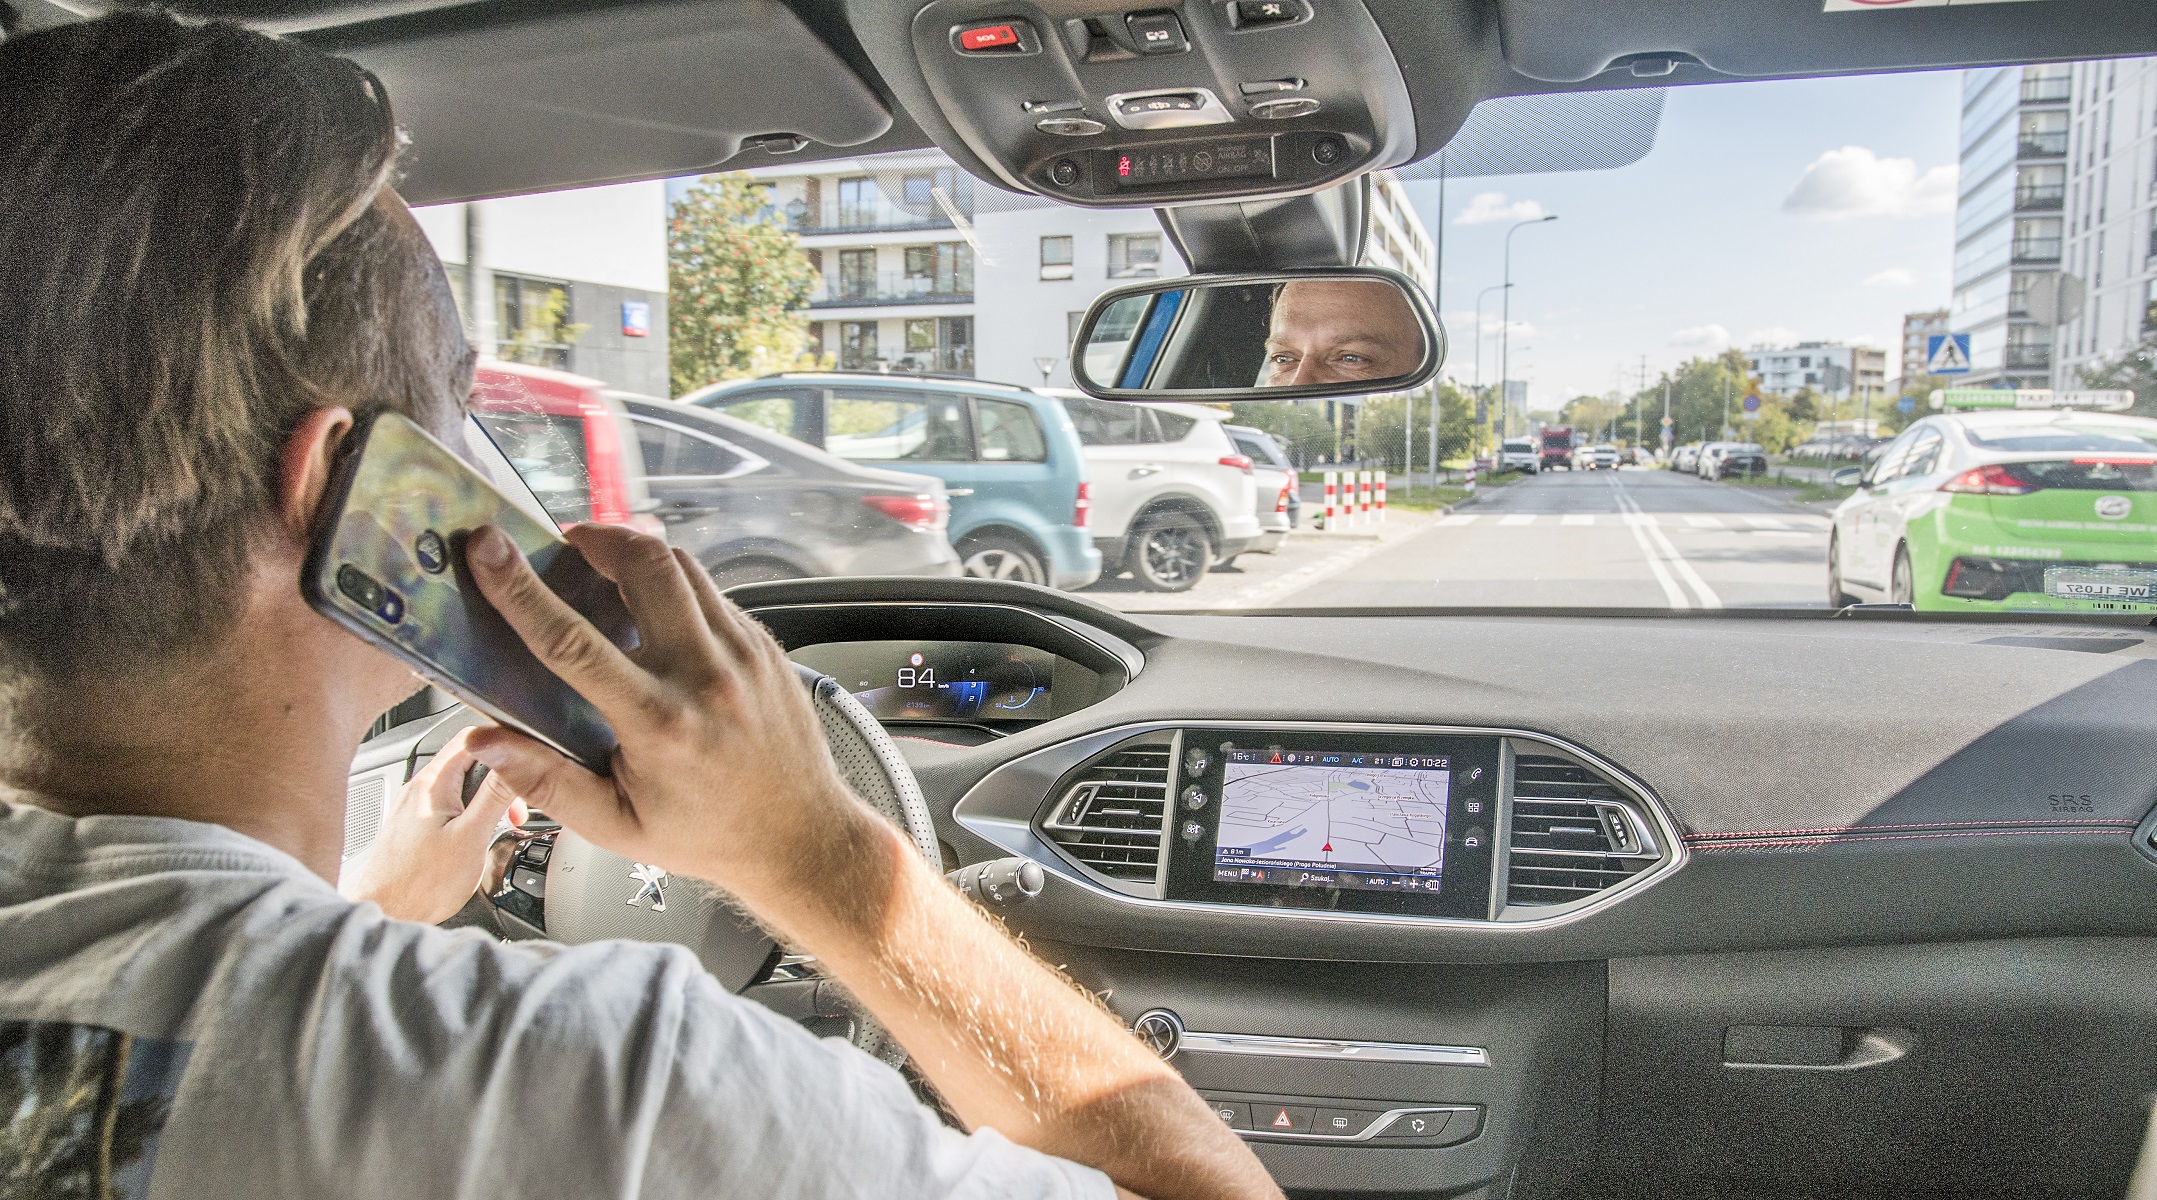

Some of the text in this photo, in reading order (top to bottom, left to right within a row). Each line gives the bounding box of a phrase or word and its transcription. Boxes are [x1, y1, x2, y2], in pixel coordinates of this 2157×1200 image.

[976, 34, 996, 43] SOS
[897, 667, 936, 689] 84
[1374, 757, 1384, 765] 21
[1421, 758, 1447, 768] 10:22
[2048, 794, 2093, 806] SRS
[1217, 869, 1238, 877] MENU
